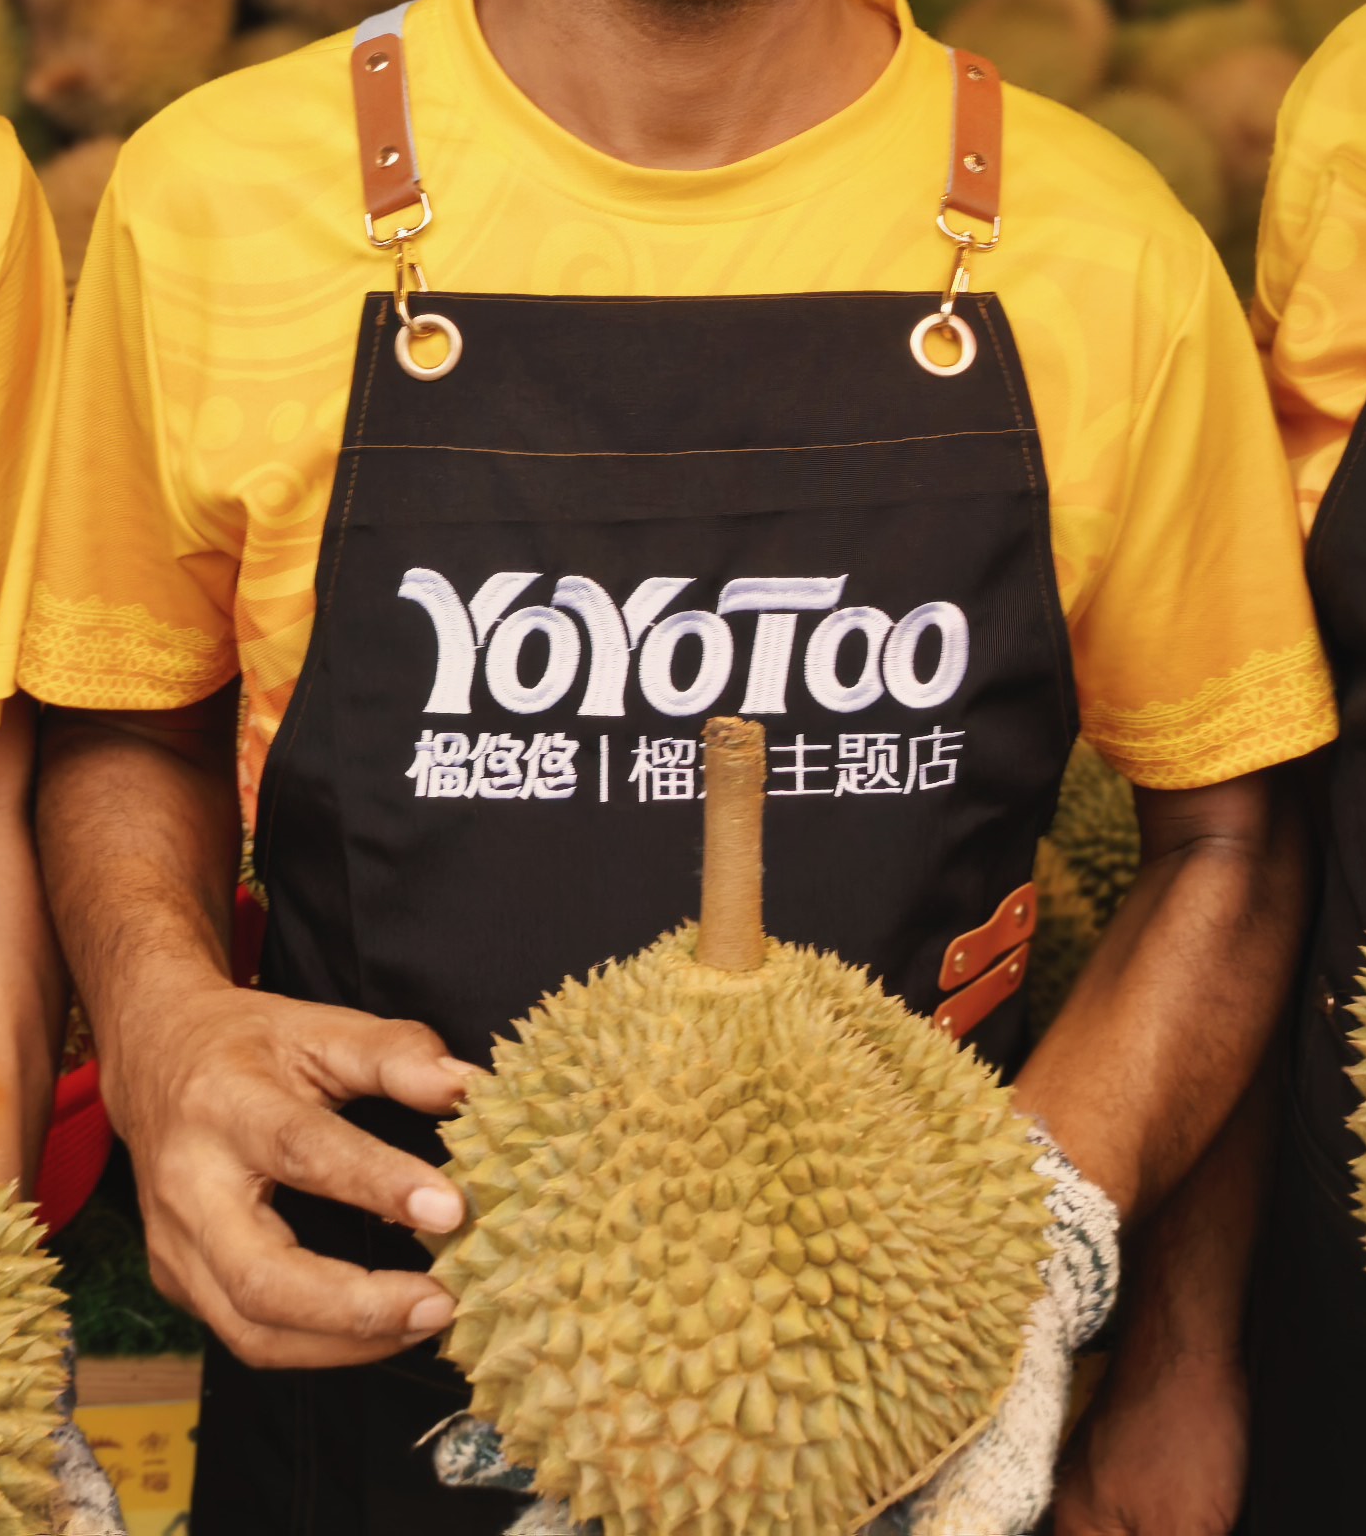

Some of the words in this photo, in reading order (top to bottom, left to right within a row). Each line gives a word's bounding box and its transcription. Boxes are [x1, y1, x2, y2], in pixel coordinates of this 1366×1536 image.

[405, 729, 580, 799] 榴悠悠
[628, 725, 966, 802] 榴主题店
